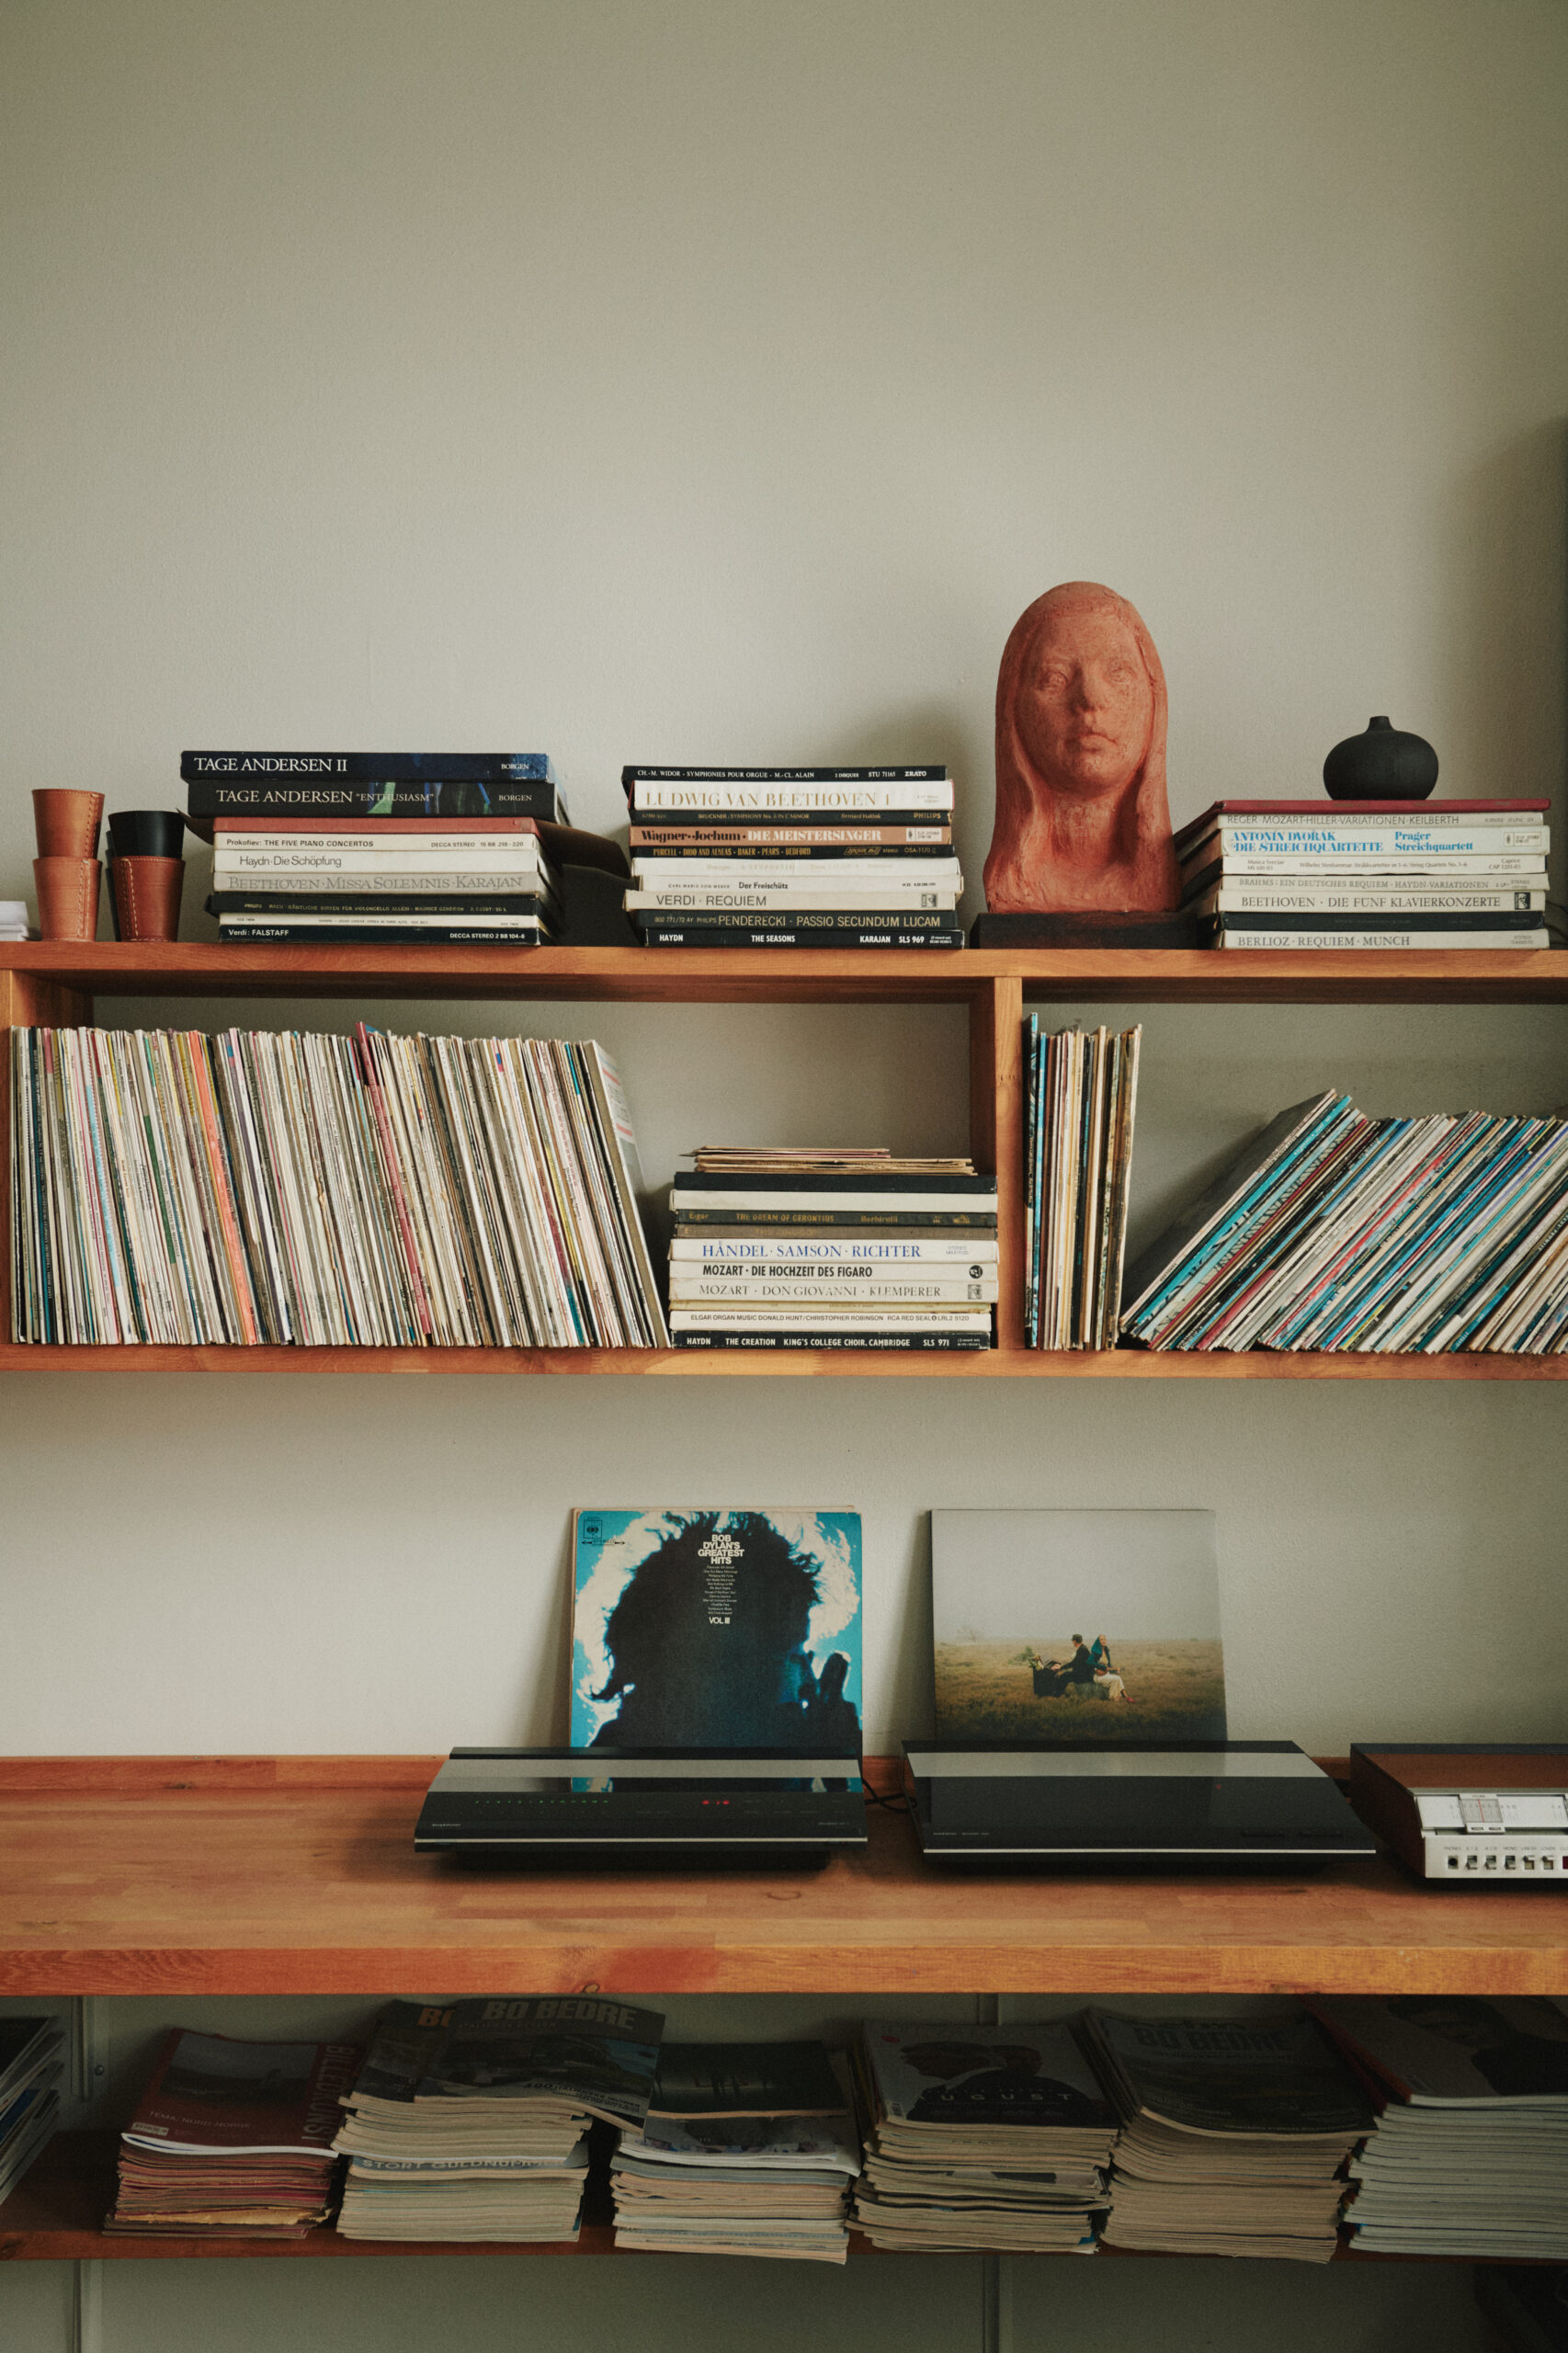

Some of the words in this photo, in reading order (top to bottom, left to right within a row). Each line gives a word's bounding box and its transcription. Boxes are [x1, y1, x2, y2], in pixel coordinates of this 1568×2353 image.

[194, 757, 238, 770] TAGE
[241, 758, 332, 771] ANDERSEN
[336, 758, 347, 771] II
[216, 790, 260, 802] TAGE
[262, 790, 353, 802] ANDERSEN
[646, 792, 721, 806] LUDWIG
[727, 792, 758, 806] VAN
[766, 792, 876, 807] BEETHOVEN
[1227, 815, 1257, 824] REGER
[1409, 816, 1460, 824] KEILBERTH
[642, 830, 688, 843] Wagner
[693, 830, 741, 841] Jochum
[747, 830, 770, 842] DIE
[773, 830, 882, 842] MEISTERSINGER
[1395, 831, 1431, 841] Prager
[227, 838, 262, 847] Prokofiev:
[1233, 842, 1256, 852] DIE
[1258, 842, 1384, 853] STREICHQUARTETTE
[1394, 842, 1473, 853] Streichquartett
[738, 848, 756, 857] BAKER
[785, 847, 811, 856] BEDFORD
[240, 856, 270, 868] Haydn
[273, 856, 290, 866] Die
[291, 856, 342, 868] Schöpfung
[739, 881, 752, 890] Der
[754, 881, 789, 890] Freischütz
[1239, 878, 1274, 887] BRAHMS
[1280, 879, 1295, 887] EIN
[1298, 879, 1346, 888] DEUTSCHES
[1349, 880, 1389, 889] REQUIEM
[1429, 881, 1489, 889] VARIATIONEN
[656, 895, 696, 905] VERDI
[706, 895, 767, 906] REQUIEM
[1242, 896, 1315, 907] BEETHOVEN
[1328, 897, 1348, 907] DIE
[1391, 897, 1501, 907] KLAVIERKONZERTE
[718, 915, 786, 926] PENDERECKI
[796, 915, 834, 926] PASSIO
[837, 916, 900, 927] SECUNDUM
[903, 916, 941, 927] LUCAM
[659, 934, 684, 942] HAYDN
[912, 936, 925, 944] 969
[1238, 937, 1290, 947] BERLIOZ
[1298, 937, 1355, 948] REQUIEM
[777, 1245, 843, 1257] SAMSON
[852, 1245, 922, 1257] RICHTER
[703, 1265, 744, 1276] MOZART
[751, 1266, 766, 1276] DIE
[768, 1266, 815, 1277] HOCHZEIT
[818, 1267, 835, 1277] DES
[837, 1267, 873, 1277] FIGARO
[699, 1285, 749, 1295] MOZART
[762, 1286, 790, 1296] DON
[793, 1286, 857, 1296] GIOVANNI
[869, 1287, 941, 1297] KLEMPERER
[687, 1337, 711, 1346] HAYDN
[725, 1337, 739, 1346] THE
[783, 1337, 808, 1346] KING'S
[810, 1338, 842, 1347] COLLEGE
[869, 1338, 911, 1347] CAMBRIDGE
[711, 1534, 732, 1542] BOB
[702, 1541, 741, 1550] DYLAN'S
[698, 1549, 744, 1557] GREATEST
[710, 1556, 732, 1564] HITS
[709, 1617, 724, 1625] VOL
[482, 2000, 528, 2020] BO
[534, 2000, 639, 2030] BEDRE
[362, 2160, 423, 2170] STORT
